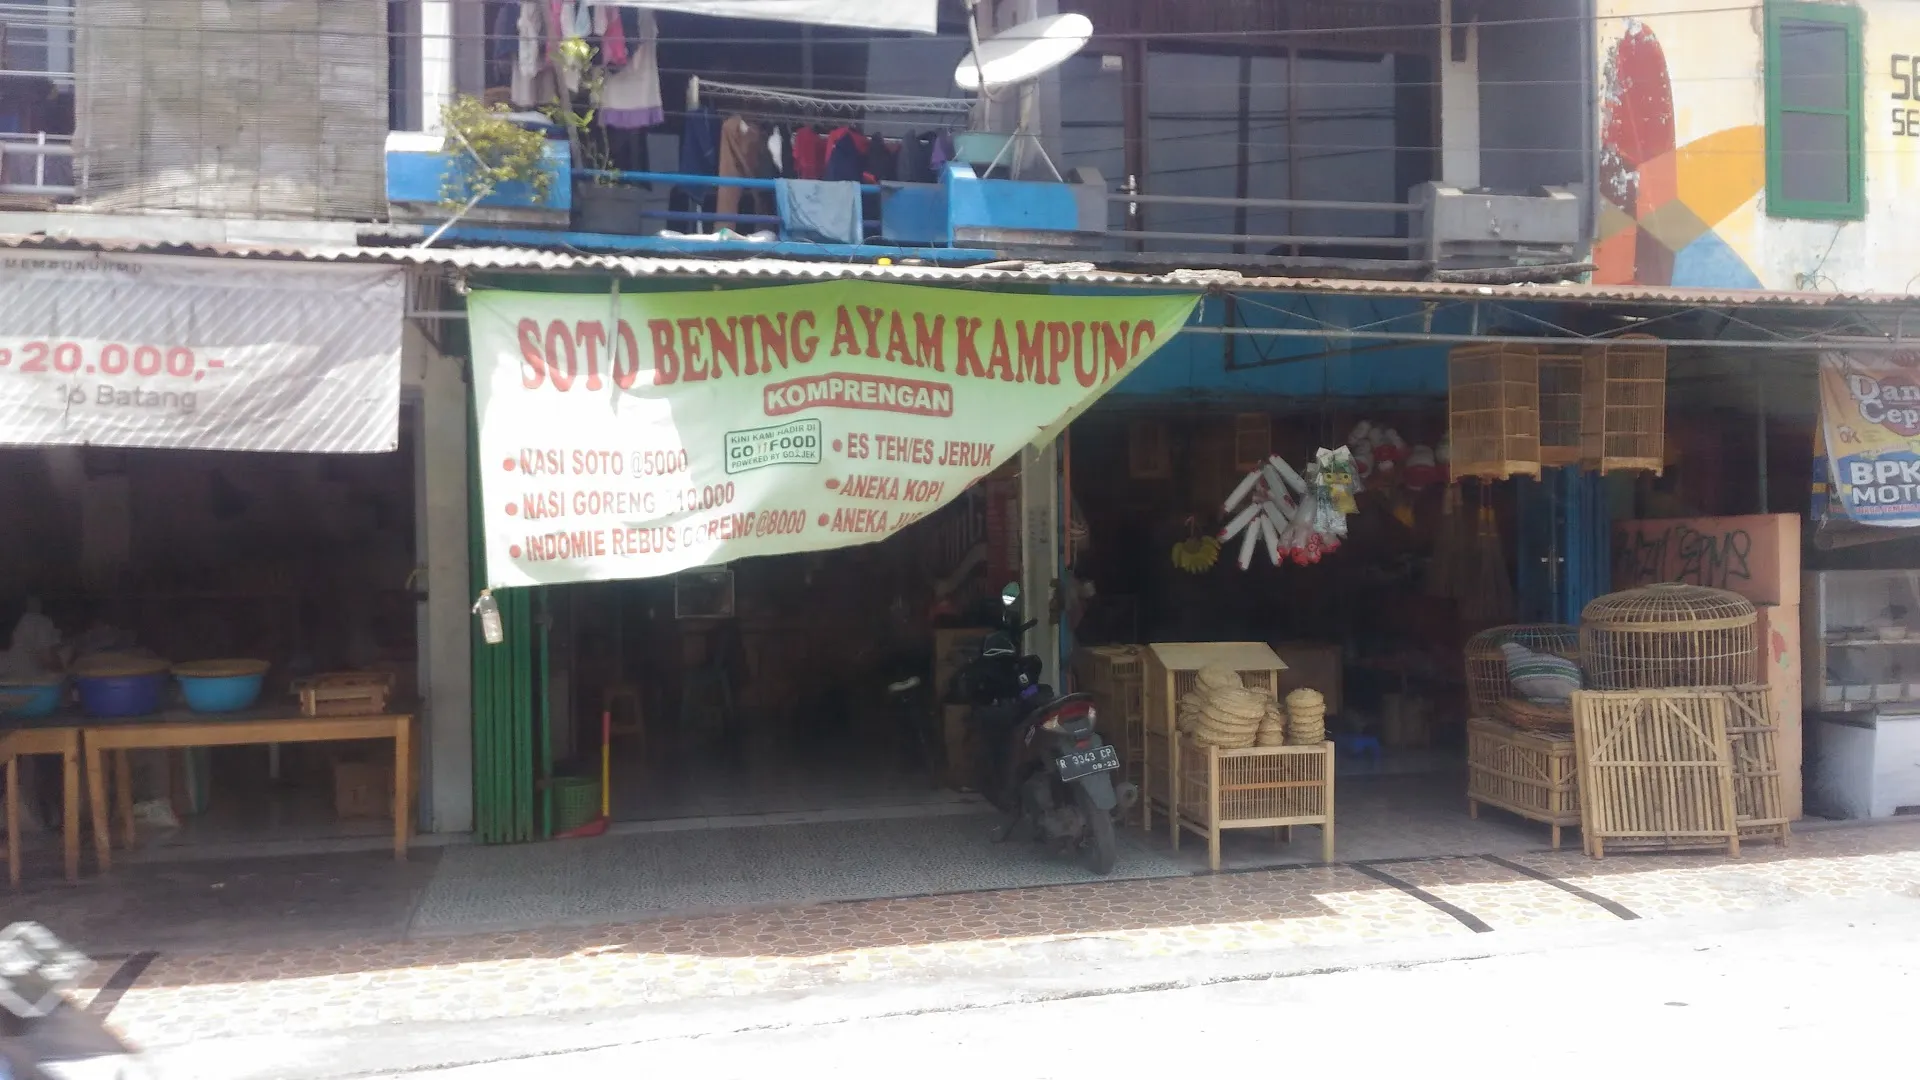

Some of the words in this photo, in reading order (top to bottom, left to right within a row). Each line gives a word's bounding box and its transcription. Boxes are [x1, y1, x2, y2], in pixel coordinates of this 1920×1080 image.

[19, 341, 225, 381] 20.000,-
[517, 317, 640, 392] SOTO
[648, 310, 820, 386] BENING
[830, 304, 946, 373] AYAM
[56, 384, 87, 405] 16
[96, 384, 198, 413] Batang
[767, 378, 951, 412] KOMPRENGAN
[731, 436, 750, 444] KINI
[753, 432, 775, 441] KAMI
[777, 425, 804, 436] HADIR
[807, 424, 816, 432] DI
[520, 448, 565, 476] NASI
[572, 448, 624, 476] SOTO
[630, 448, 689, 479] @5000
[732, 455, 768, 468] POWERED
[771, 453, 780, 461] BY
[847, 432, 869, 459] ES
[874, 434, 935, 465] TEH/ES
[938, 441, 995, 467] JERUK
[839, 474, 900, 501] ANEKA
[902, 479, 945, 502] KOPI
[522, 491, 566, 519] NASI
[572, 490, 656, 515] GORENG
[830, 508, 888, 533] ANEKA
[525, 530, 606, 562] INDOMIE
[1059, 759, 1068, 769] R
[1072, 752, 1096, 765] 3343
[1099, 748, 1112, 758] CP
